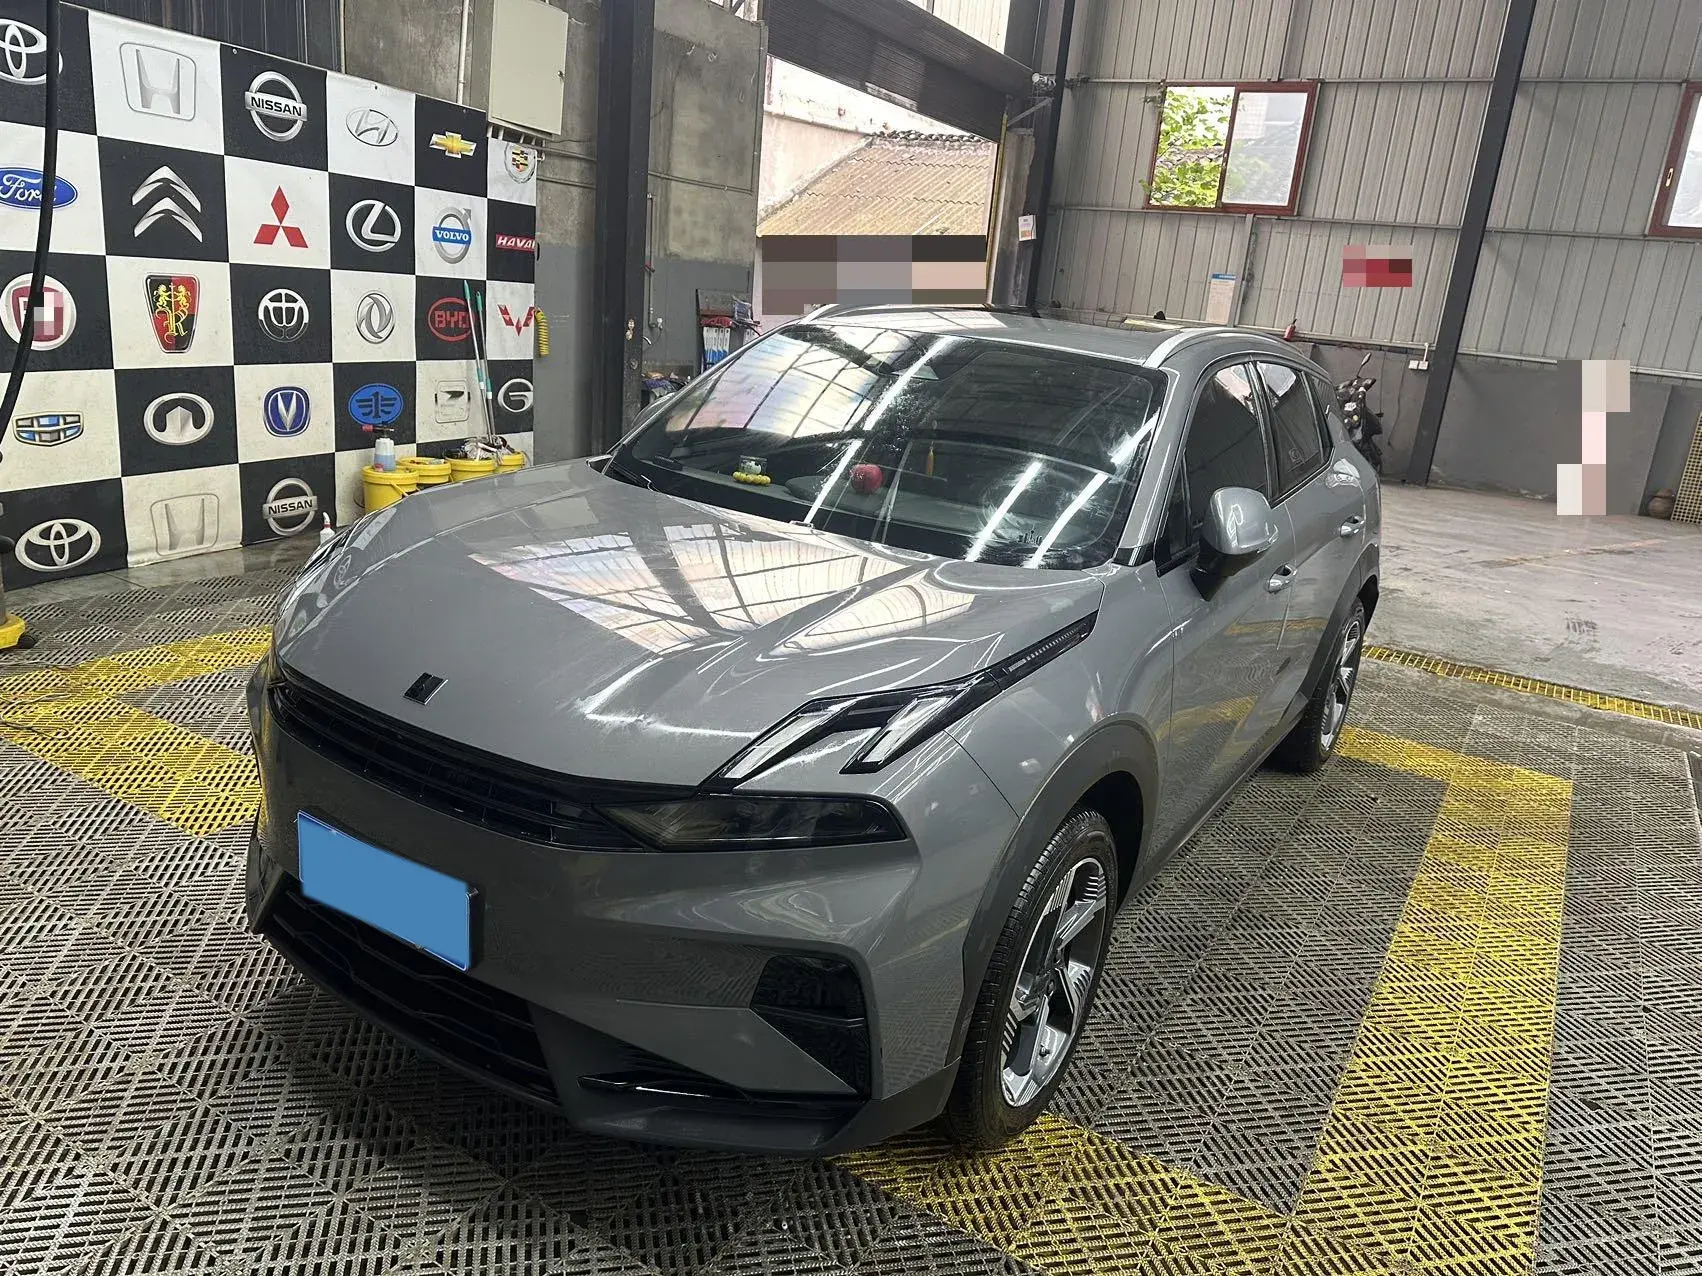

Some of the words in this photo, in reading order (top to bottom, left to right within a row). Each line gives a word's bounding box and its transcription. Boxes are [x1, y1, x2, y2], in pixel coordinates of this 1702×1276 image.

[251, 96, 302, 117] NISSAN
[0, 173, 57, 202] For
[434, 229, 470, 241] VOLVO
[268, 499, 313, 515] NISSAN
